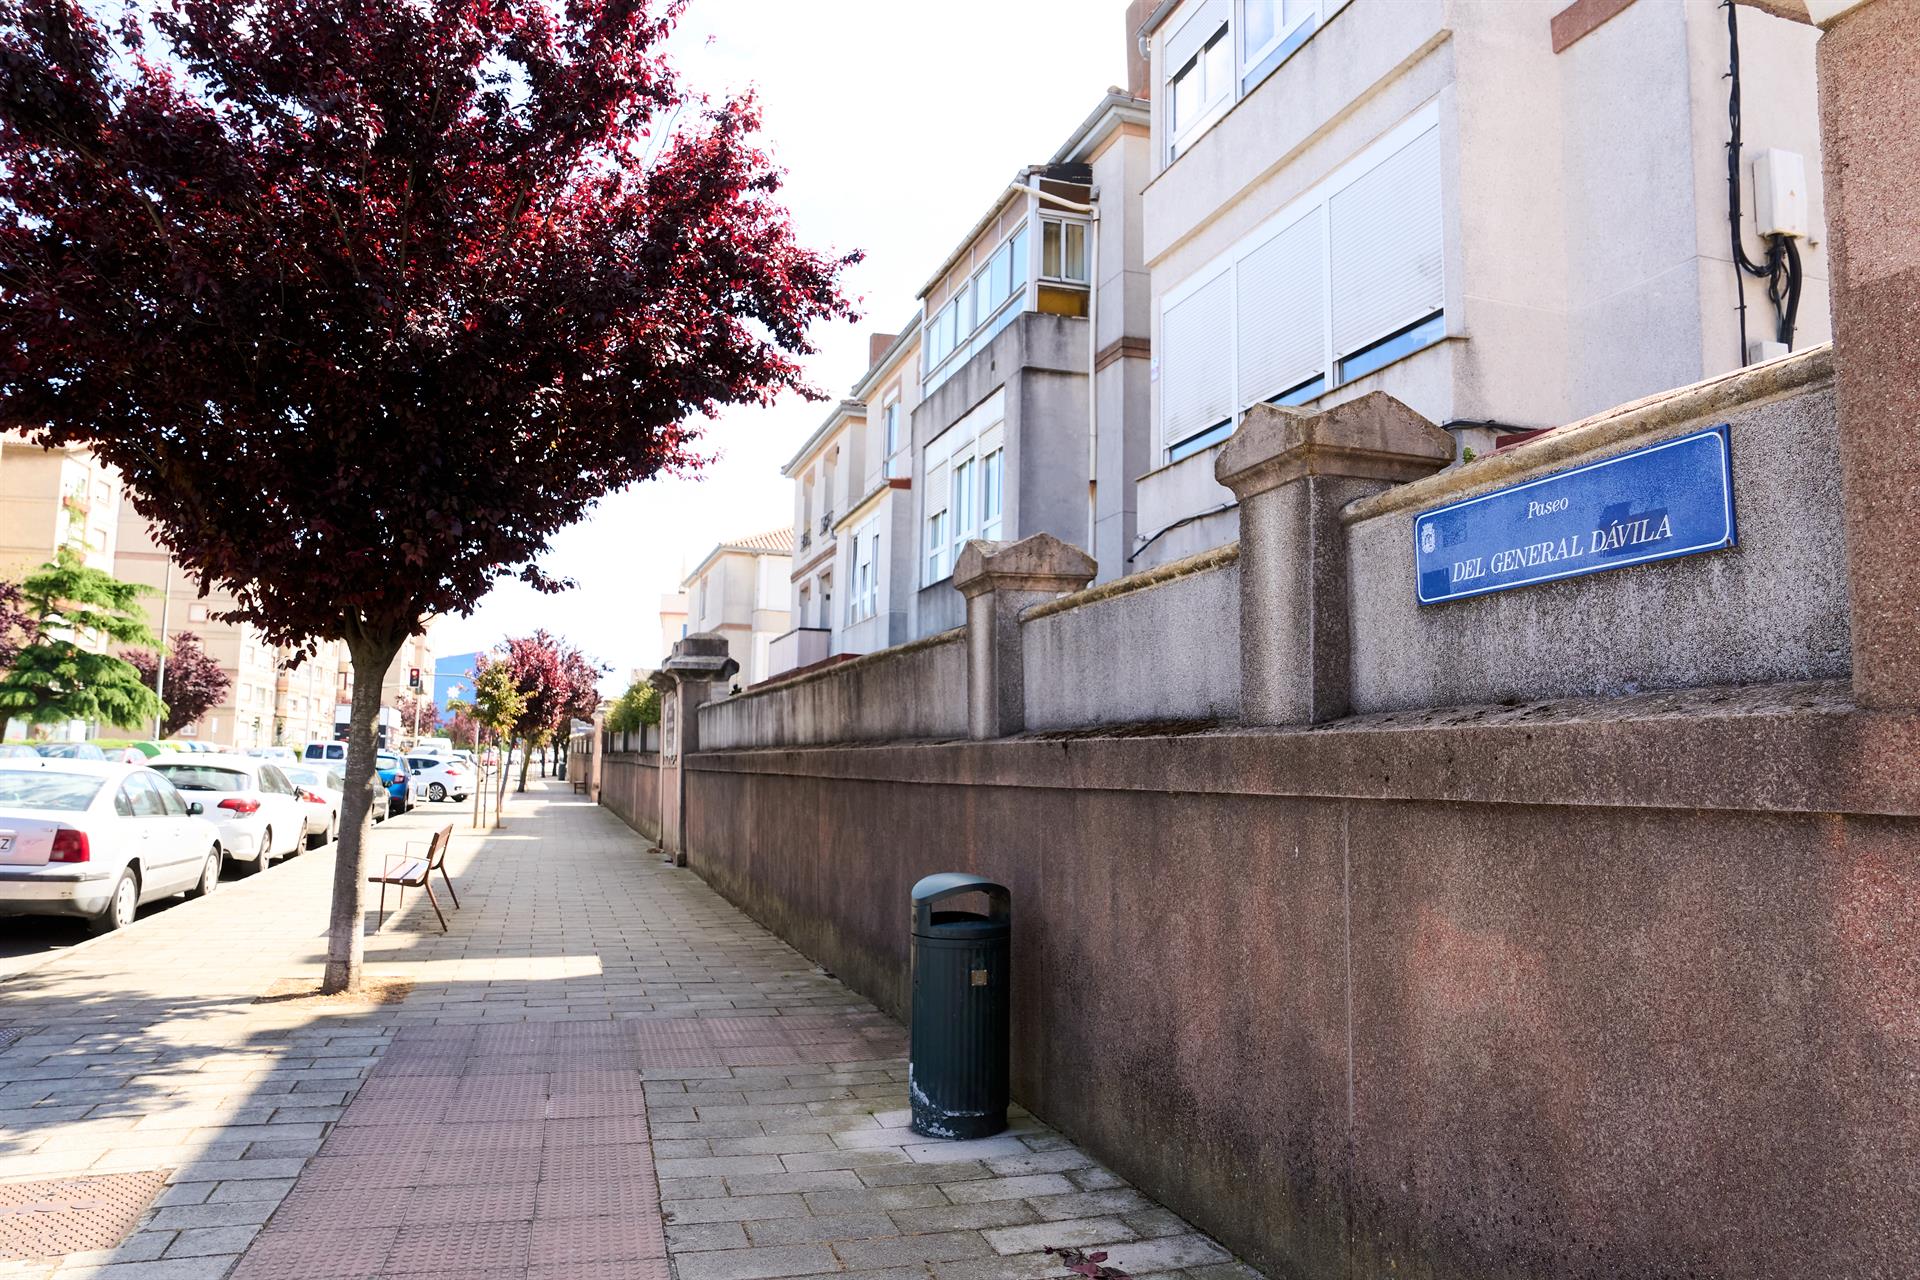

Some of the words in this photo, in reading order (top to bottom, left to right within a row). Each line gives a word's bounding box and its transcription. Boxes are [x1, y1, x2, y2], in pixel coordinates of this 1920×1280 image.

[1528, 498, 1568, 519] Paseo
[1452, 557, 1485, 582] DEL
[1491, 535, 1583, 574] GENERAL
[1589, 514, 1672, 554] DÁVILA
